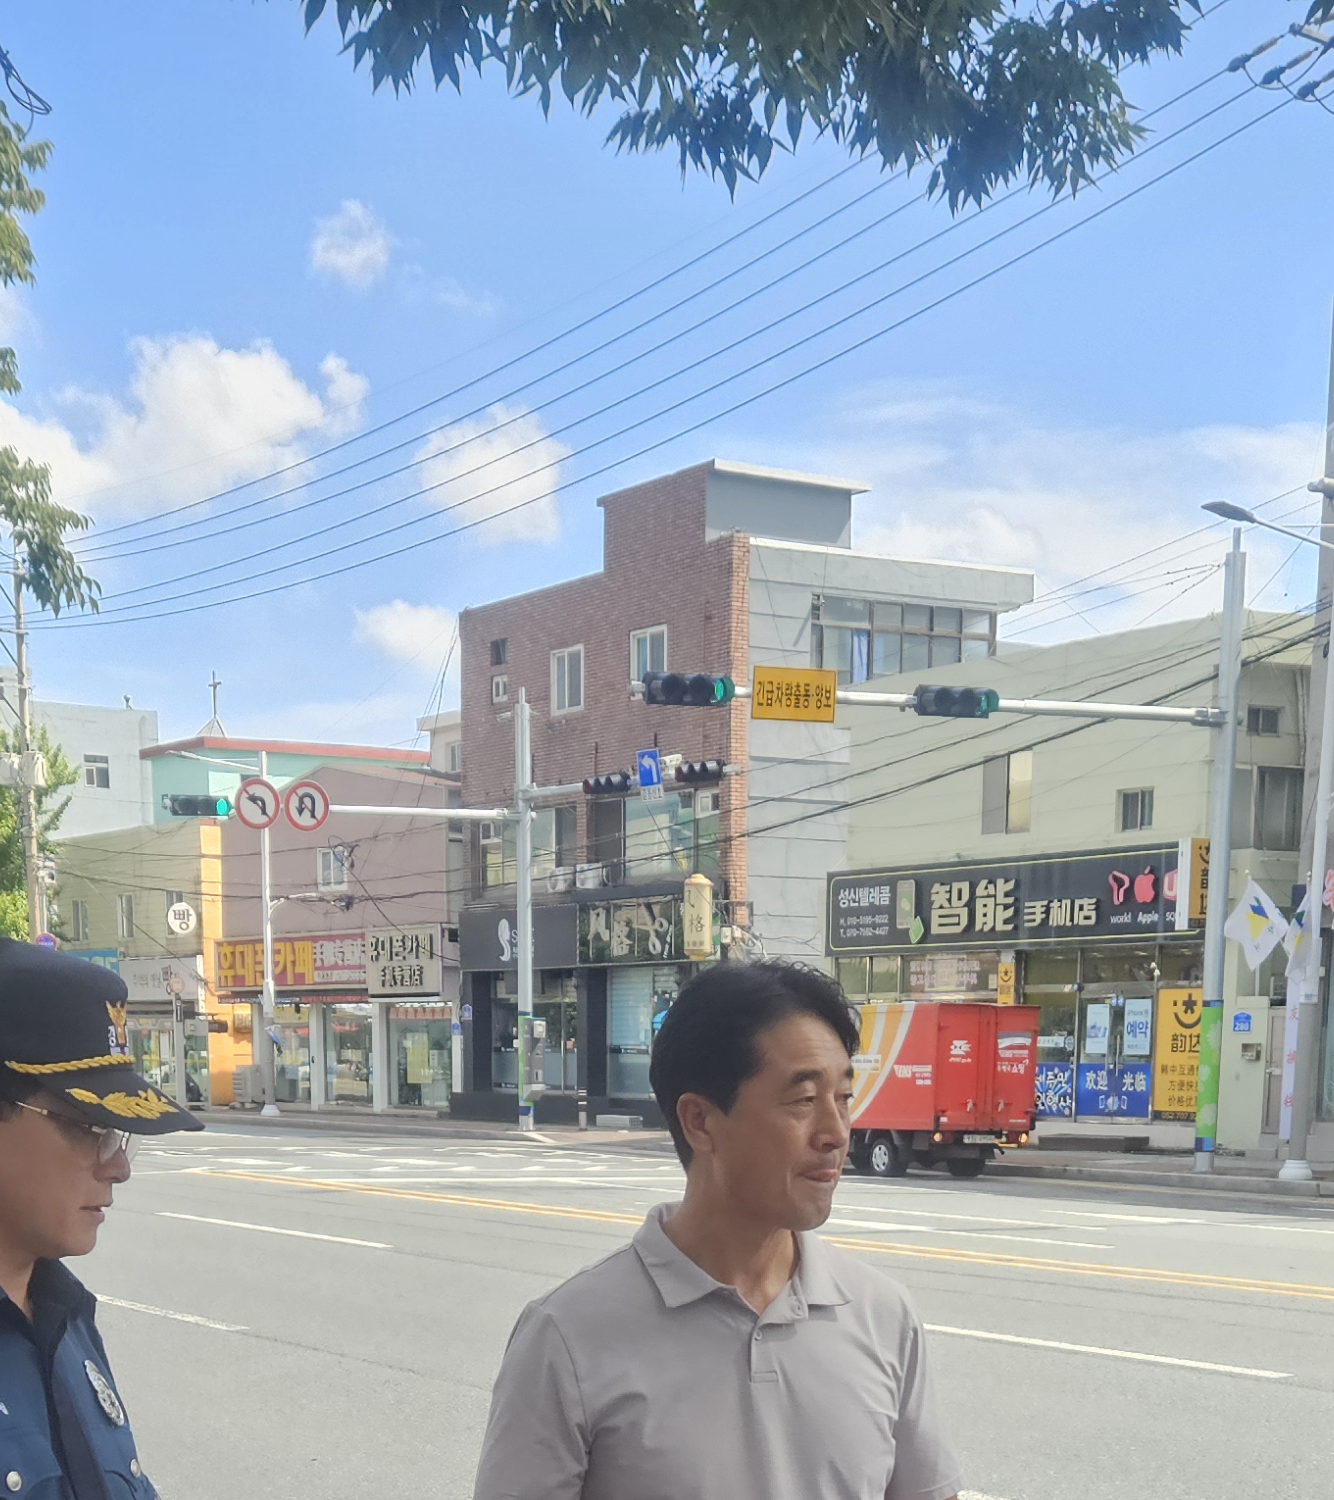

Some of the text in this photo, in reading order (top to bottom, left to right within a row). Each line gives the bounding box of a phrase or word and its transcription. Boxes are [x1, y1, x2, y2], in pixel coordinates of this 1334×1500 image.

[756, 679, 832, 709] 긴급차량출동·양보
[838, 885, 891, 908] 성신텔레콤
[930, 878, 1097, 935] 智能 手机店
[172, 908, 192, 931] 빵
[1110, 912, 1132, 924] world
[1137, 910, 1159, 925] Apple
[1126, 1020, 1149, 1039] 예약
[1235, 1022, 1249, 1031] 280
[1085, 1071, 1147, 1092] 欢迎 光临
[1167, 1080, 1198, 1092] 方便快
[1167, 1095, 1197, 1107] 价格优
